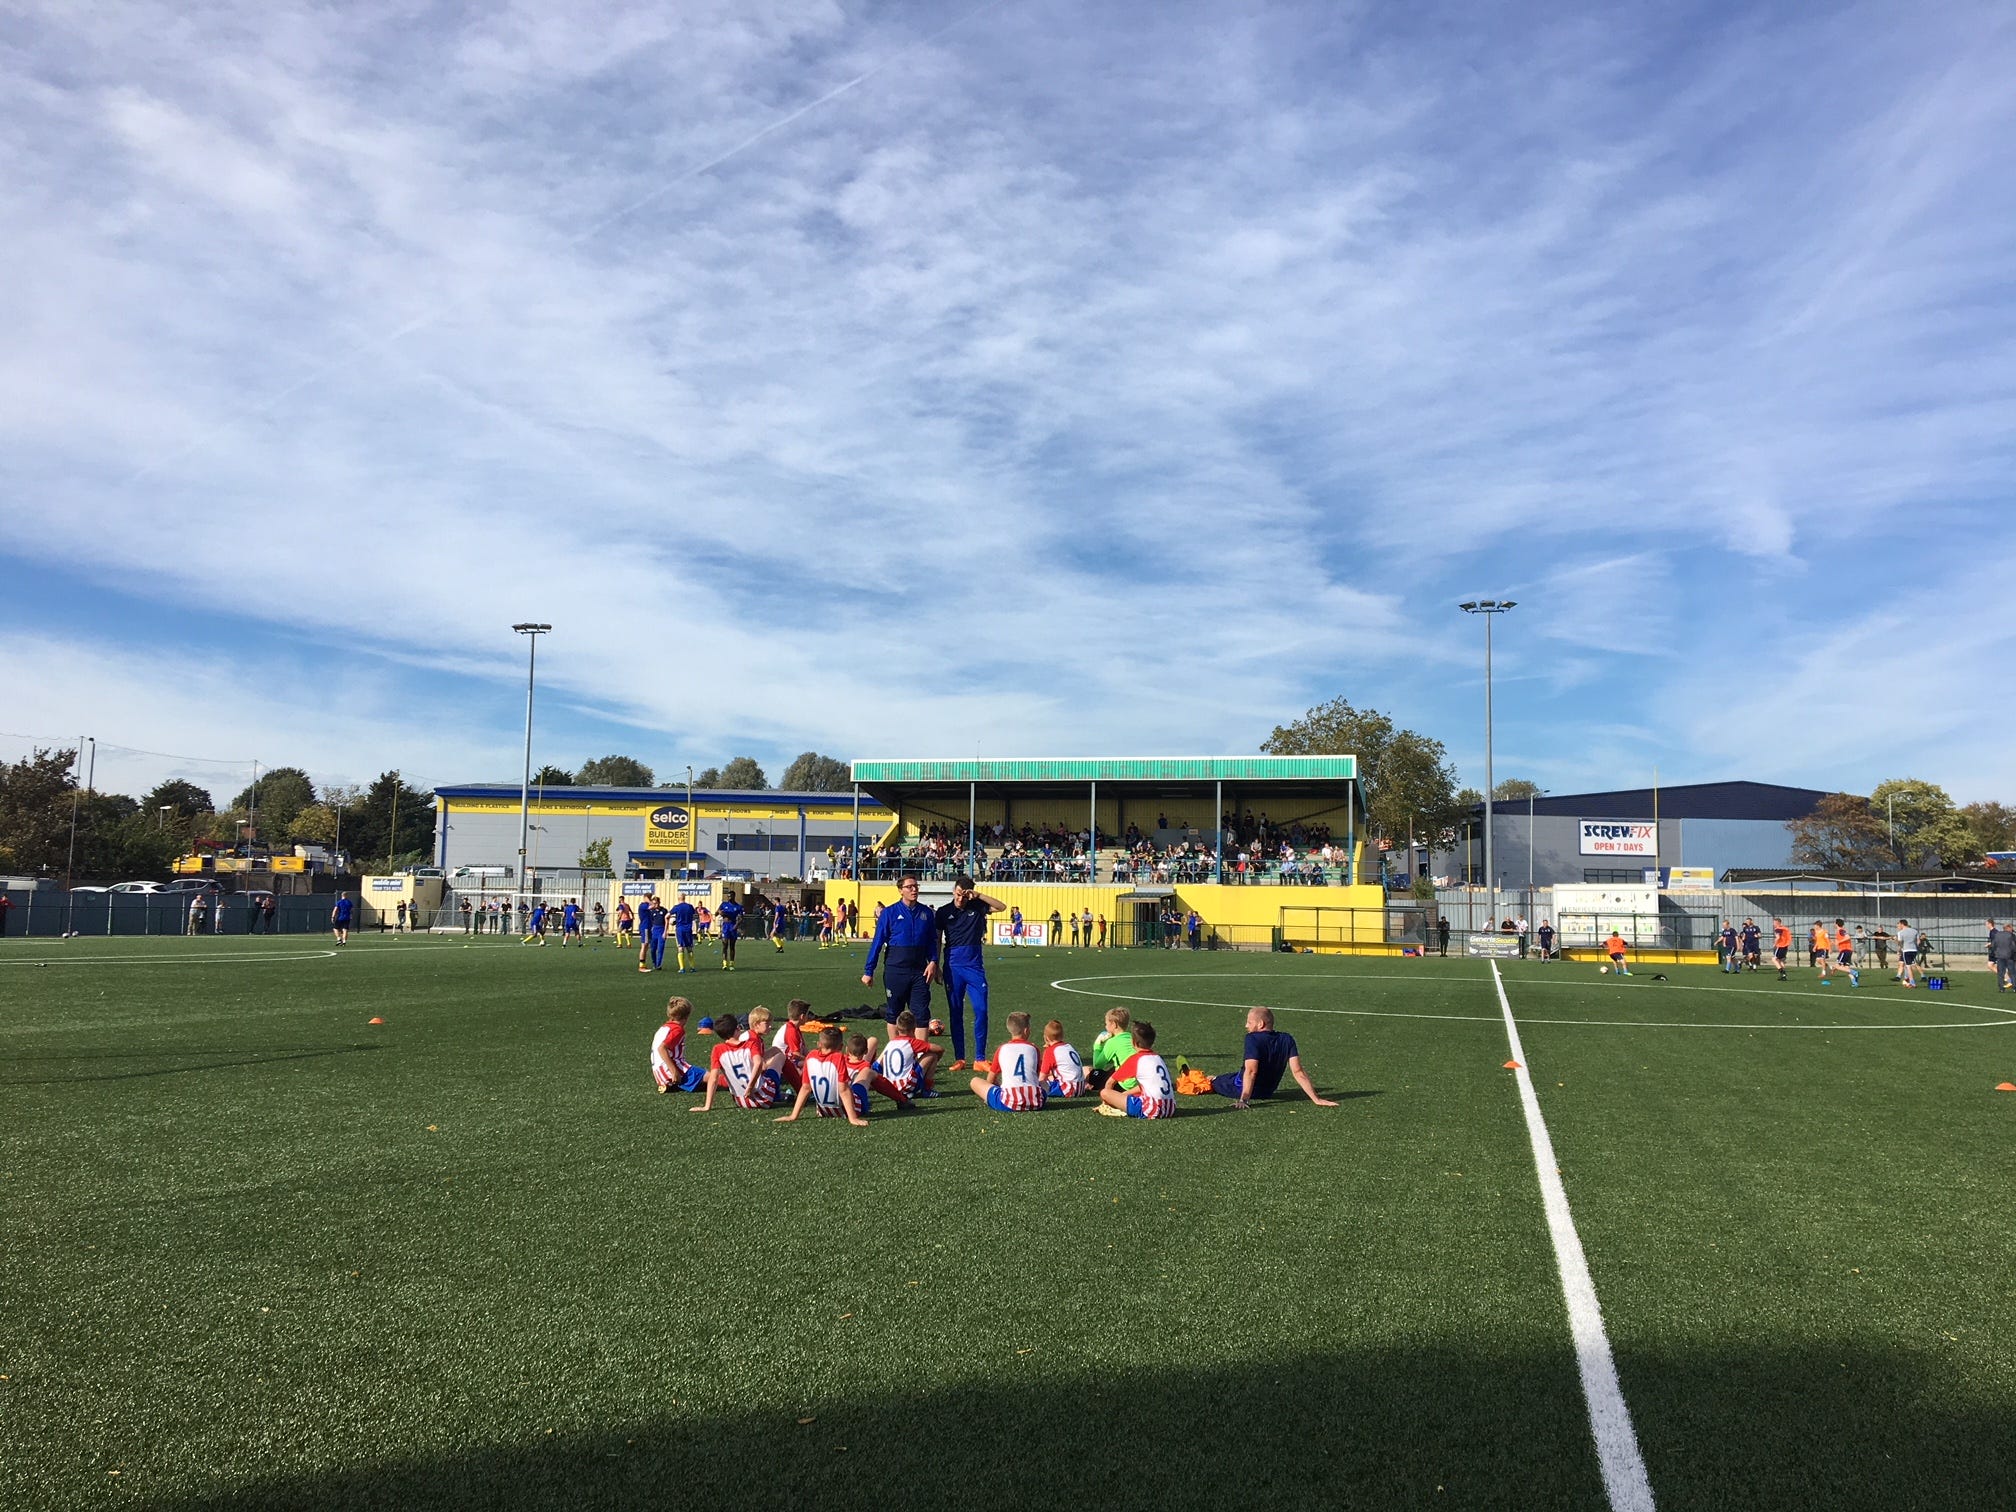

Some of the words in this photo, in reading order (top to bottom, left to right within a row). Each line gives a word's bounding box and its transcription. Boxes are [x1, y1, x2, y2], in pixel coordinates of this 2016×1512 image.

[652, 811, 688, 823] selco
[648, 830, 689, 838] BUILDERS
[1594, 842, 1615, 851] OPEN
[1617, 843, 1621, 851] 7
[1623, 843, 1644, 851] DAYS
[999, 924, 1042, 937] CS
[732, 1063, 749, 1090] 5
[884, 1048, 905, 1078] 10
[1013, 1053, 1027, 1083] 4
[811, 1075, 835, 1105] 12
[1156, 1065, 1171, 1096] 3
